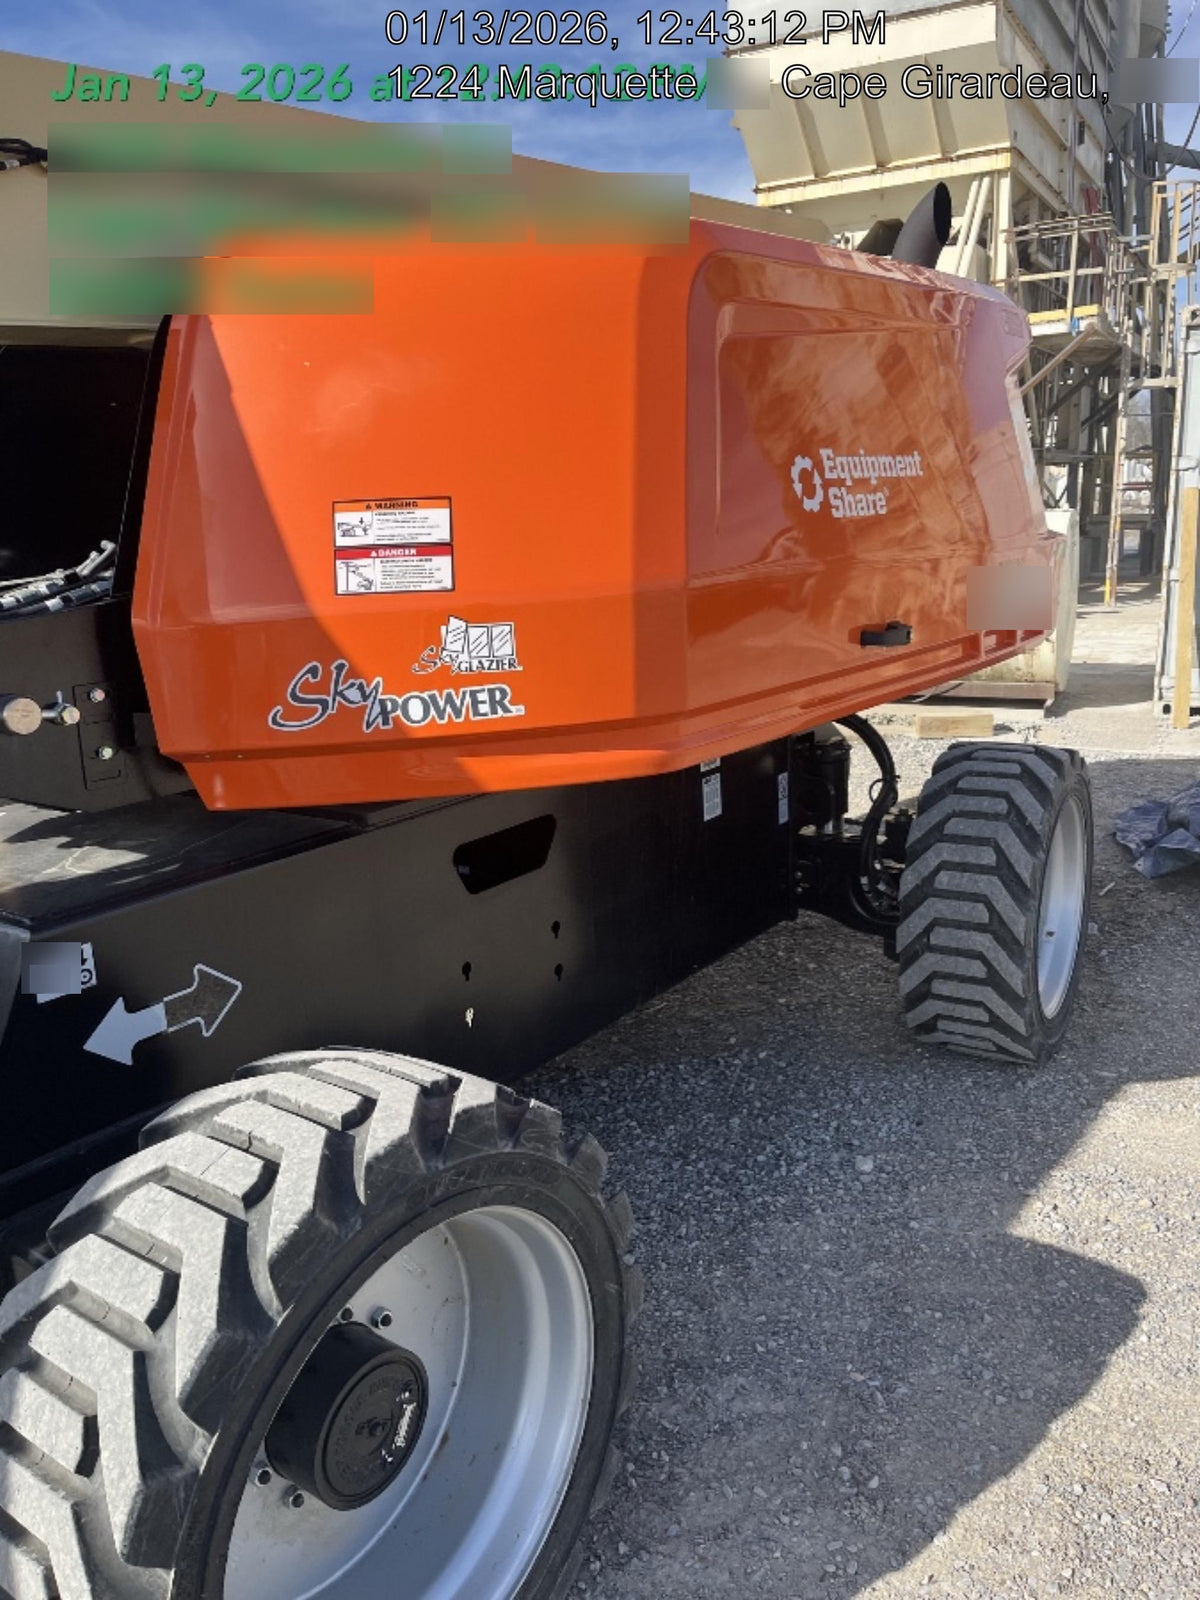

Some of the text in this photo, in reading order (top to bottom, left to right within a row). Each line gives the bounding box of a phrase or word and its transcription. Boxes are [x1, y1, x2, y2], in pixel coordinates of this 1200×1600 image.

[819, 447, 924, 485] Equipment
[374, 500, 419, 510] WARNING
[827, 486, 889, 519] Share
[378, 548, 417, 557] DANGER
